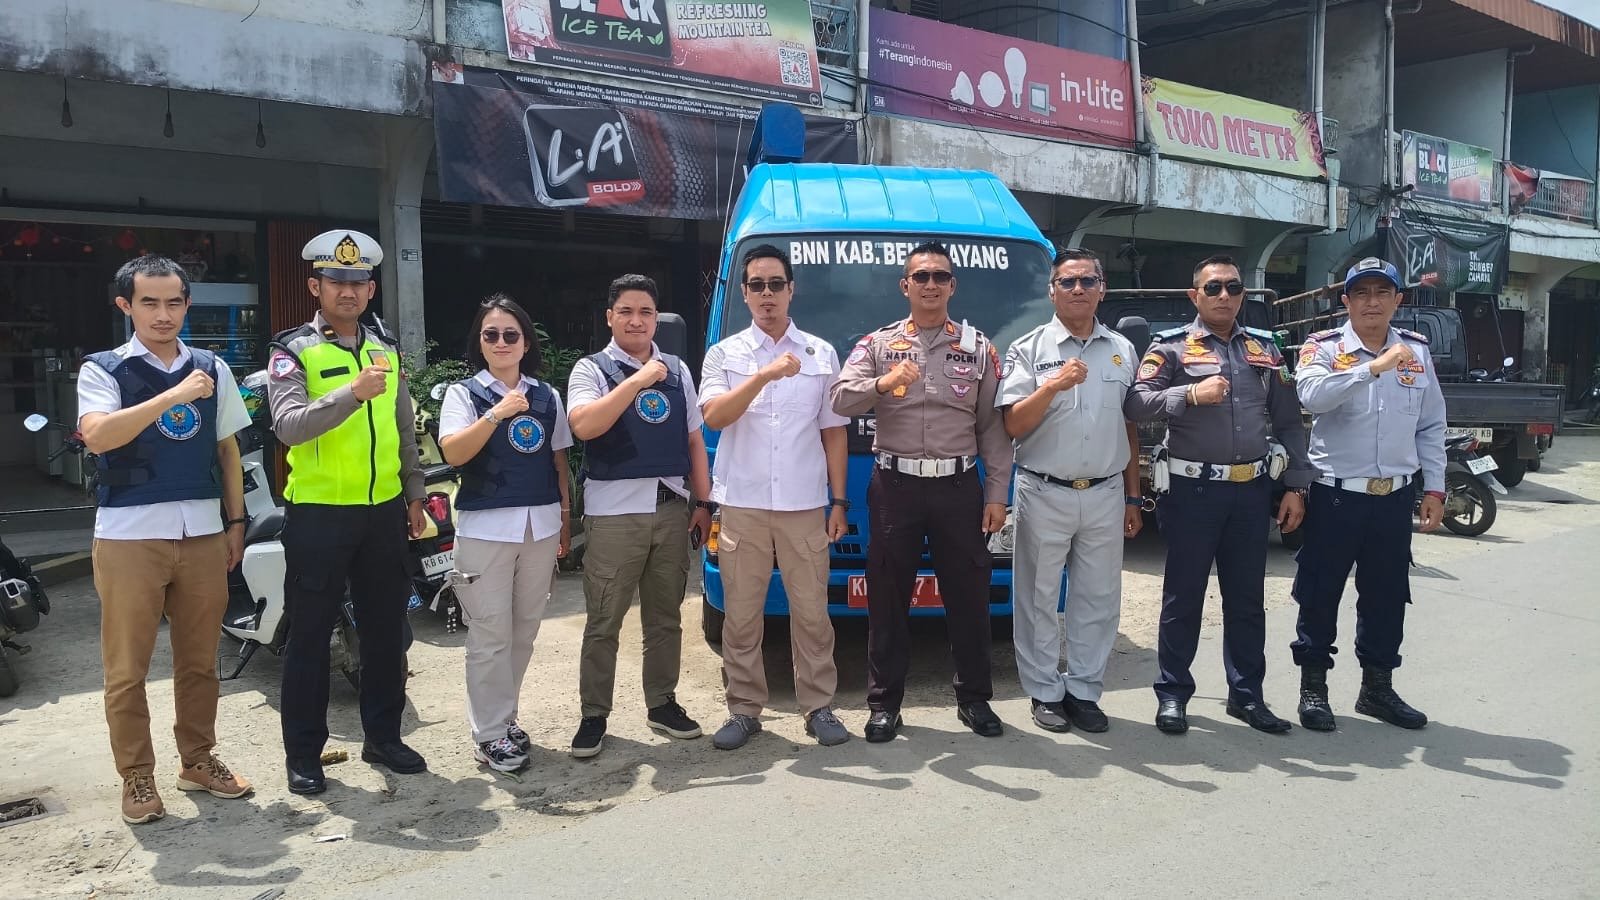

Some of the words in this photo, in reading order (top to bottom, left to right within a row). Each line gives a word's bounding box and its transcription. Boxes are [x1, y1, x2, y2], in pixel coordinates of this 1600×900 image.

[676, 3, 767, 19] REFRESHING
[561, 13, 598, 35] ICE
[604, 21, 643, 43] TEA
[678, 22, 744, 40] MOUNTAIN
[745, 22, 771, 36] TEA
[879, 48, 953, 71] #TerangIndonesia
[1156, 101, 1219, 150] TOKO
[1222, 115, 1299, 161] METTA
[592, 183, 631, 194] BOLD
[789, 241, 830, 265] BNN
[835, 240, 881, 265] KAB.
[946, 353, 977, 364] POLRI
